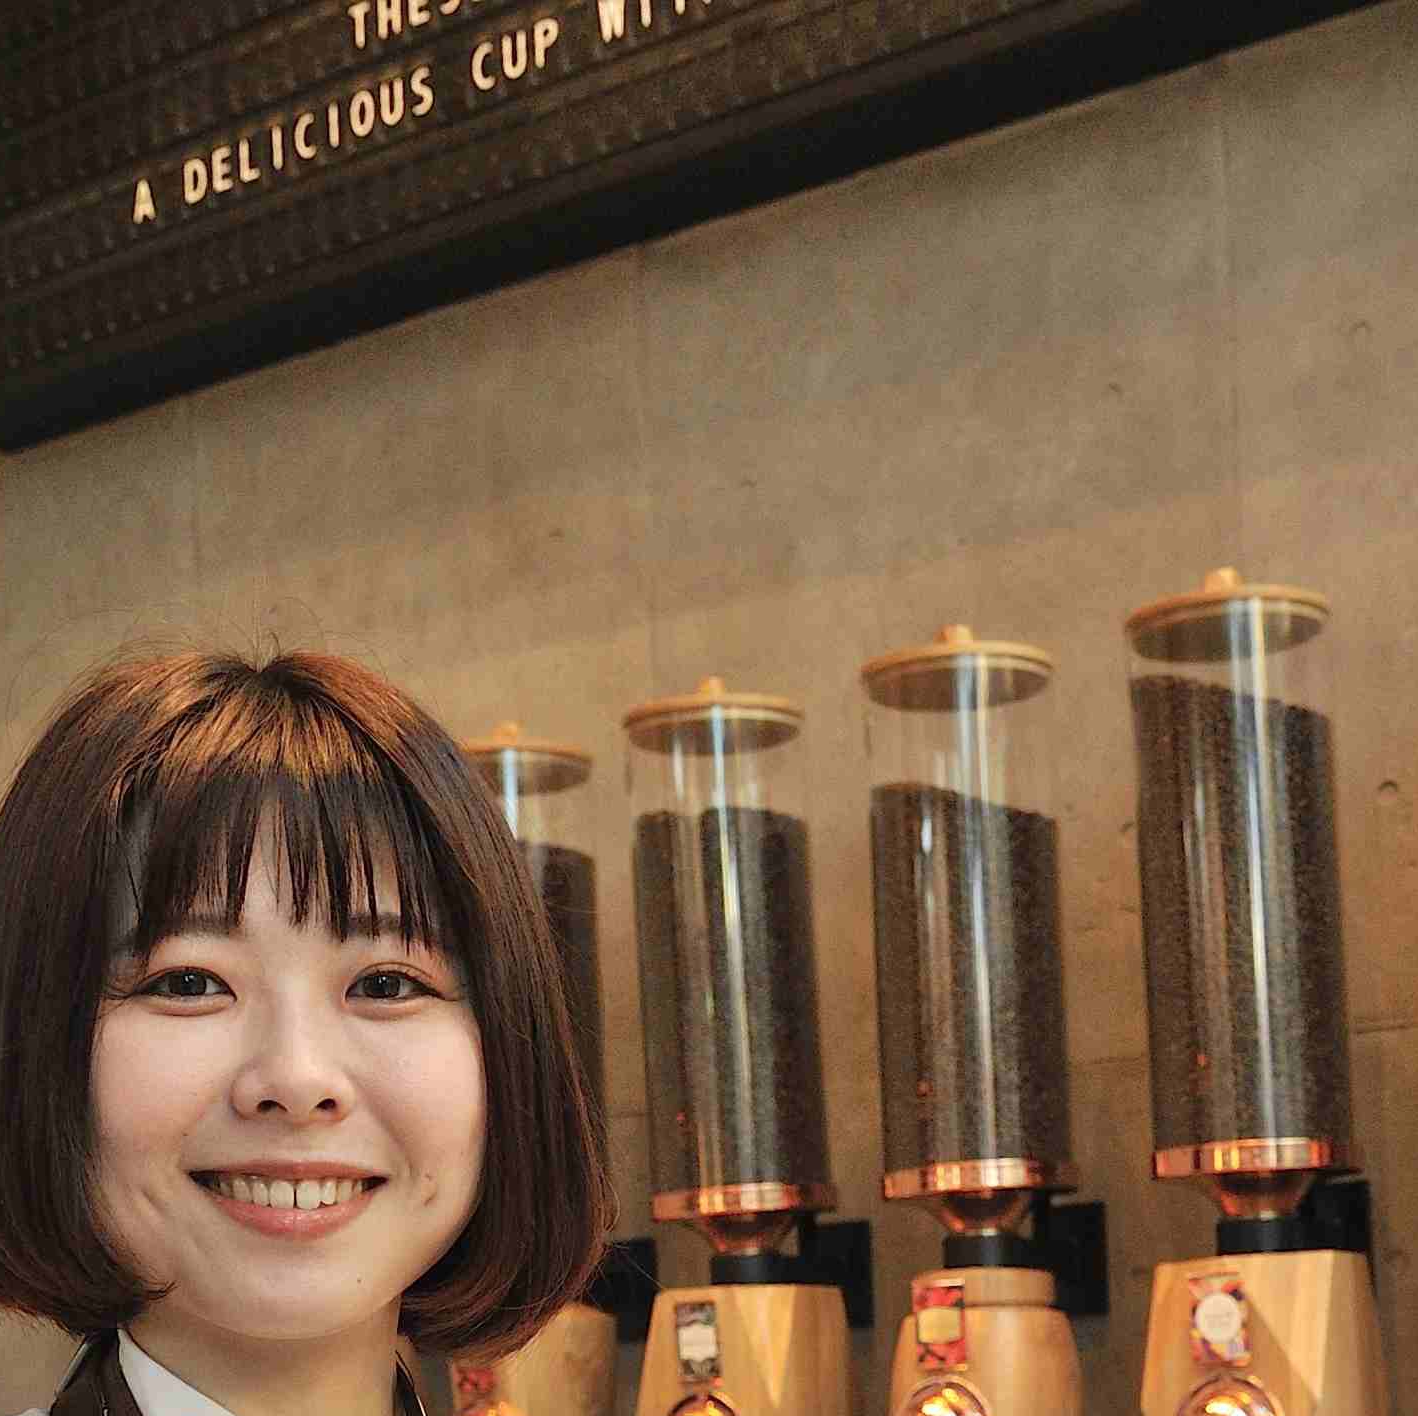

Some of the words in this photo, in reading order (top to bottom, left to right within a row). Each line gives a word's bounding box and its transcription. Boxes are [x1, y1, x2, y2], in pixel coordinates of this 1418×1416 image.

[132, 178, 158, 225] A
[183, 64, 435, 207] DELICIOUS
[470, 16, 559, 91] CUP
